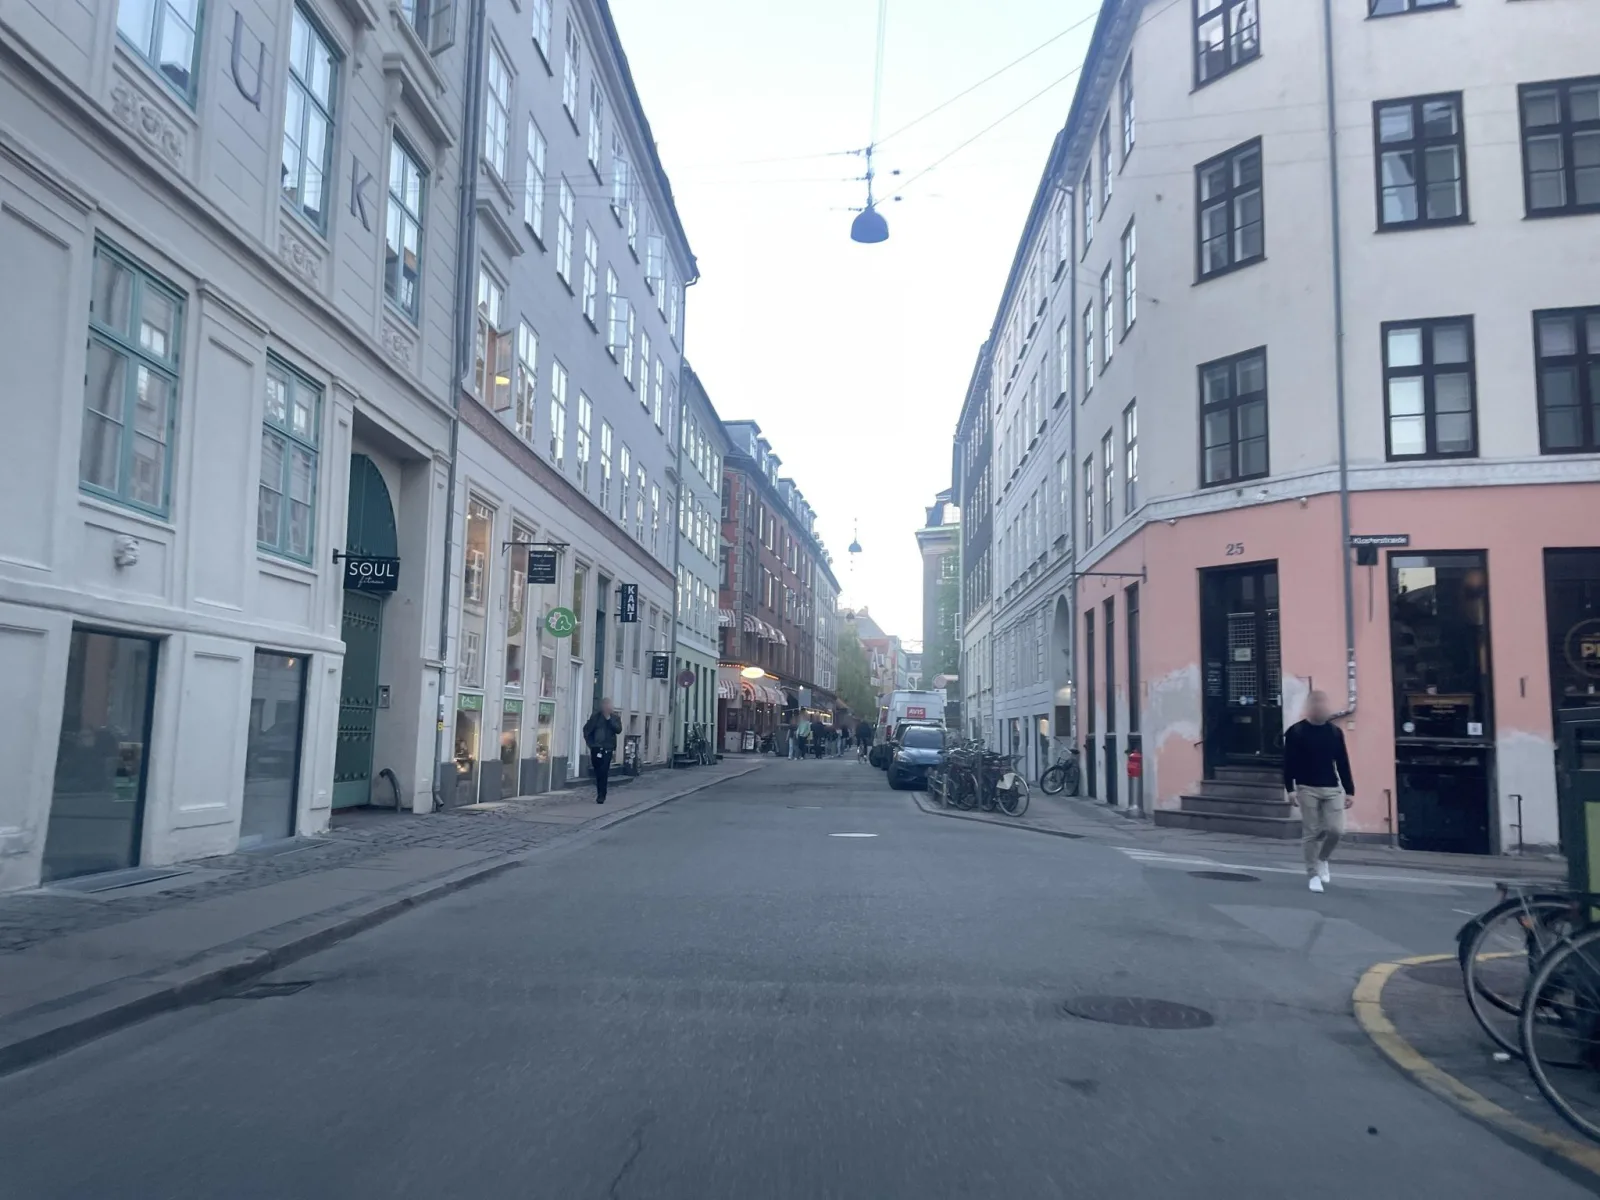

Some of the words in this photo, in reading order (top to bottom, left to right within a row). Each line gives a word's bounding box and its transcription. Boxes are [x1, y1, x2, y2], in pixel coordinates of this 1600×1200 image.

[1225, 542, 1245, 556] 25
[349, 562, 394, 577] SOUL
[626, 585, 636, 621] KANT
[1581, 643, 1600, 658] P
